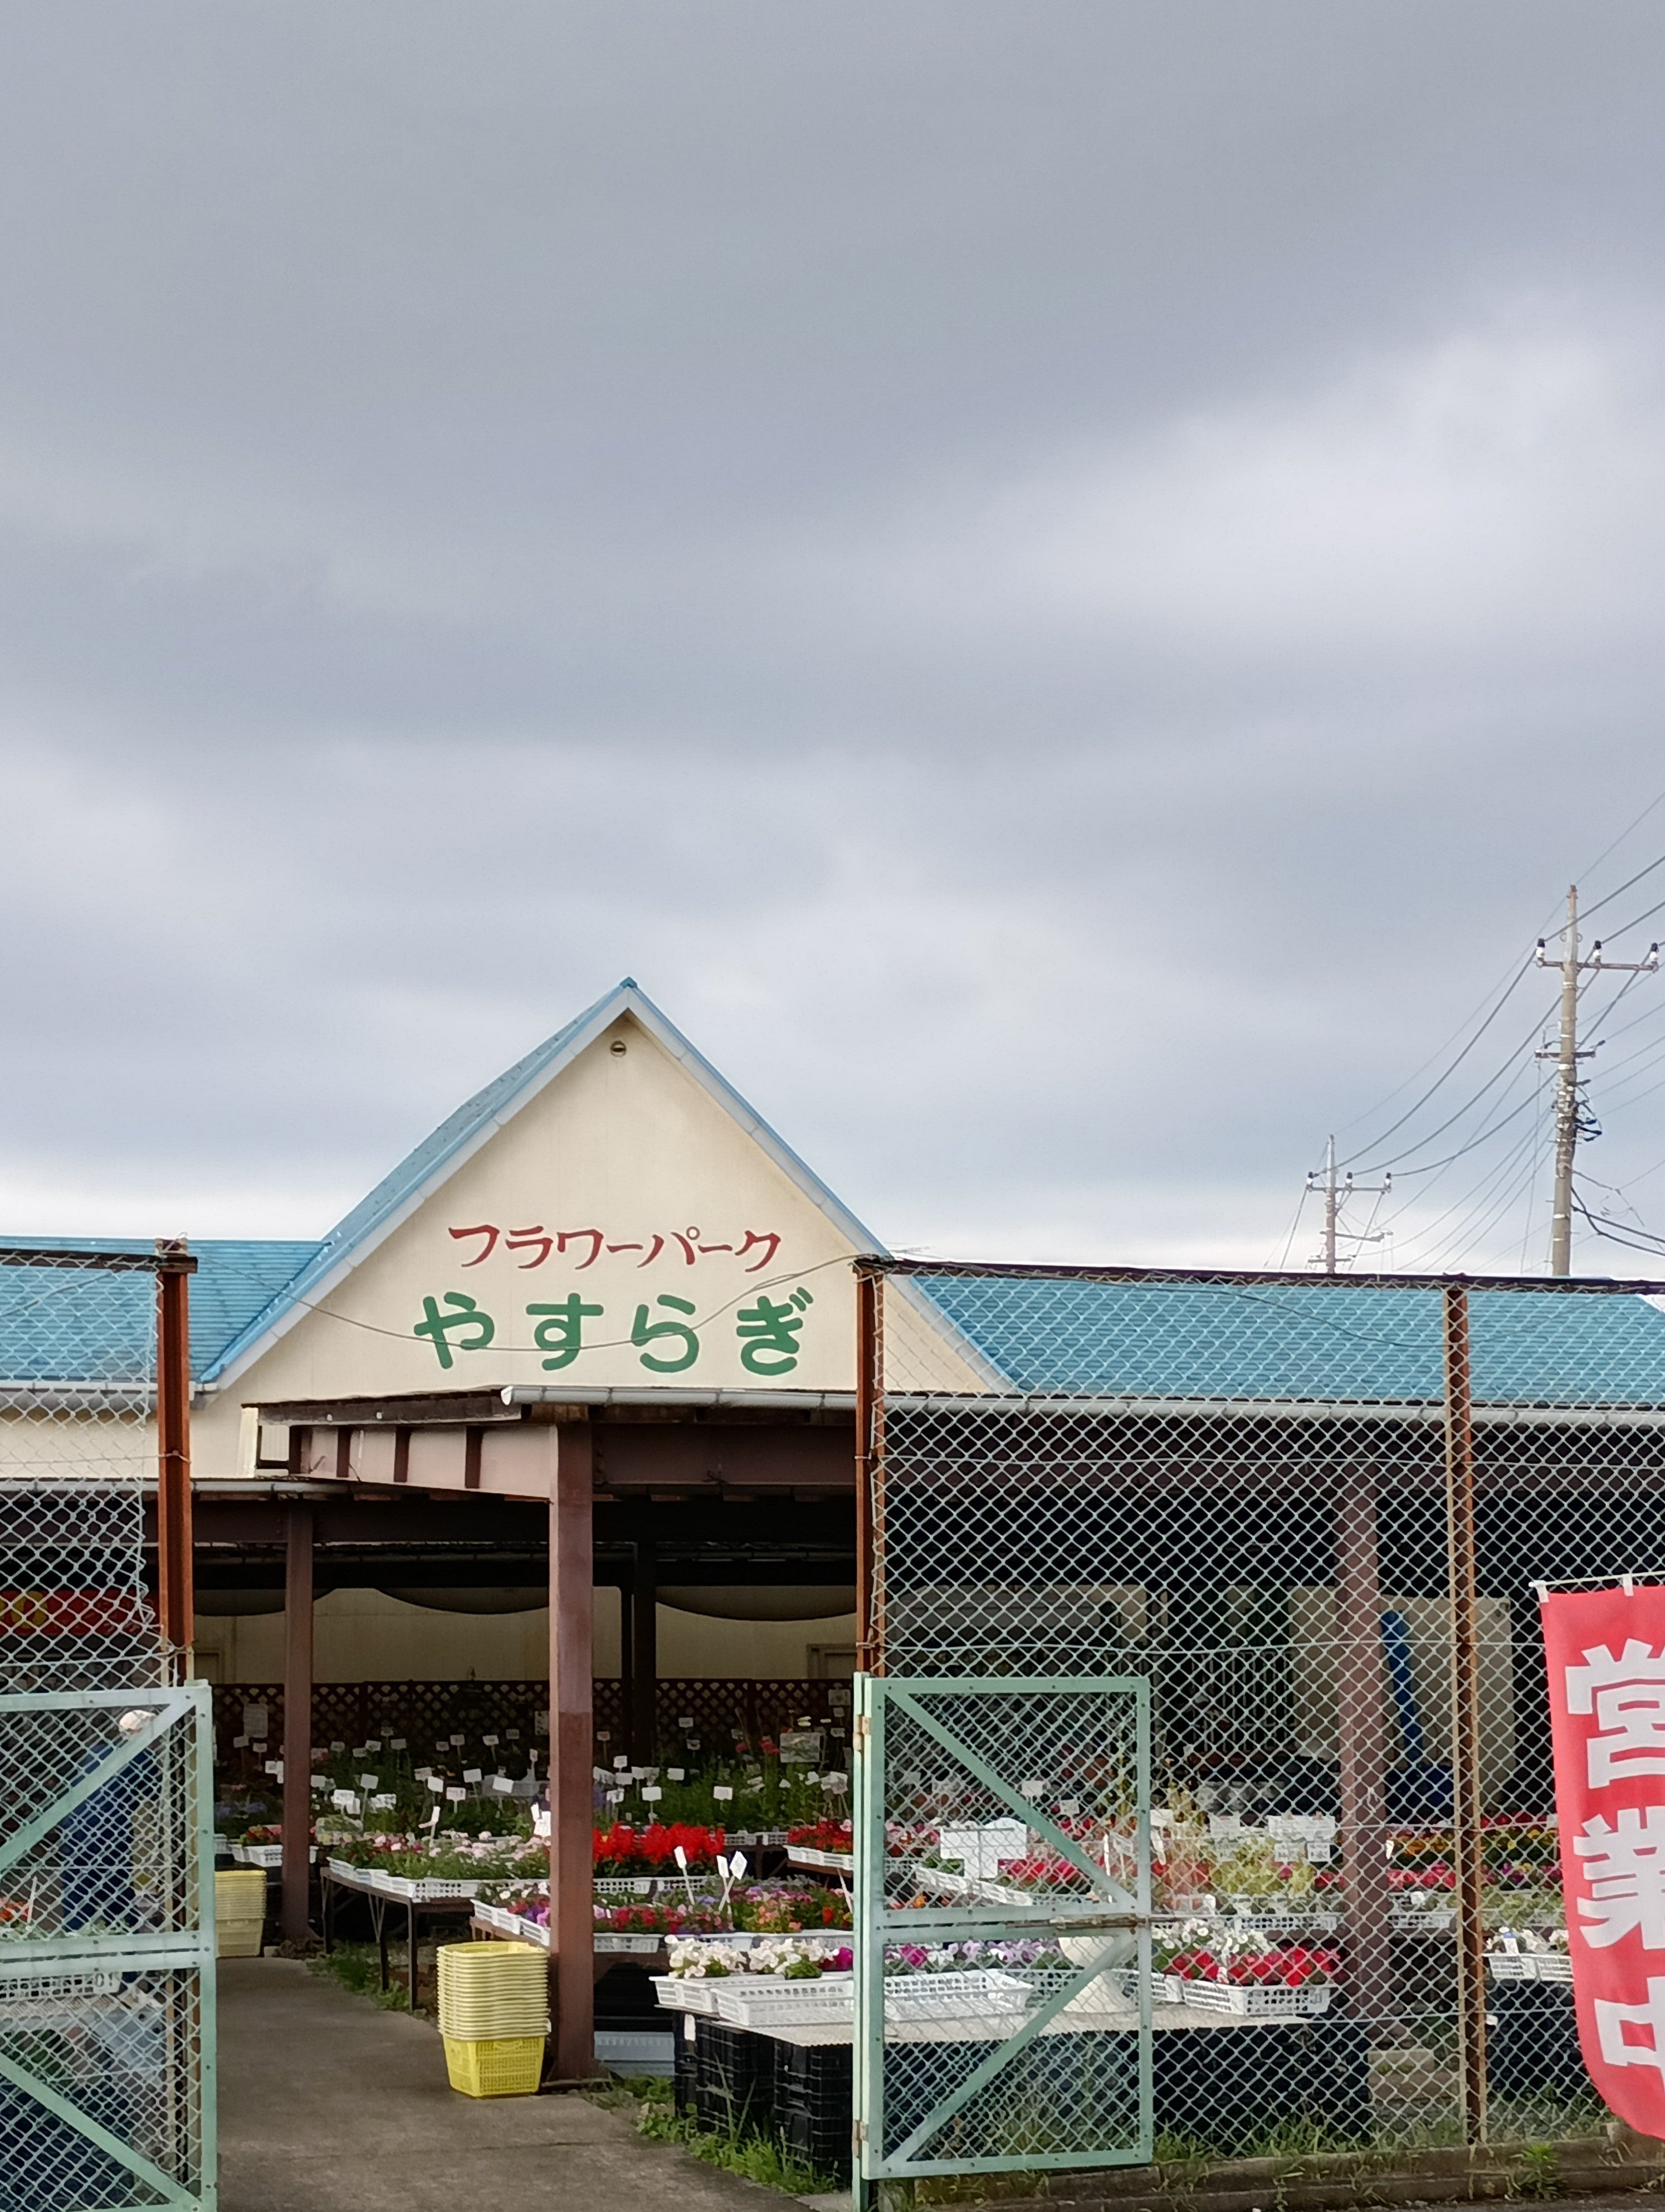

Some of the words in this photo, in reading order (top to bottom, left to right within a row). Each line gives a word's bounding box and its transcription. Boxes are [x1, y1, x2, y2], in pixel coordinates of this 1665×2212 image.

[448, 1224, 782, 1273] フラワーパーク
[413, 1287, 814, 1376] やすらぎ
